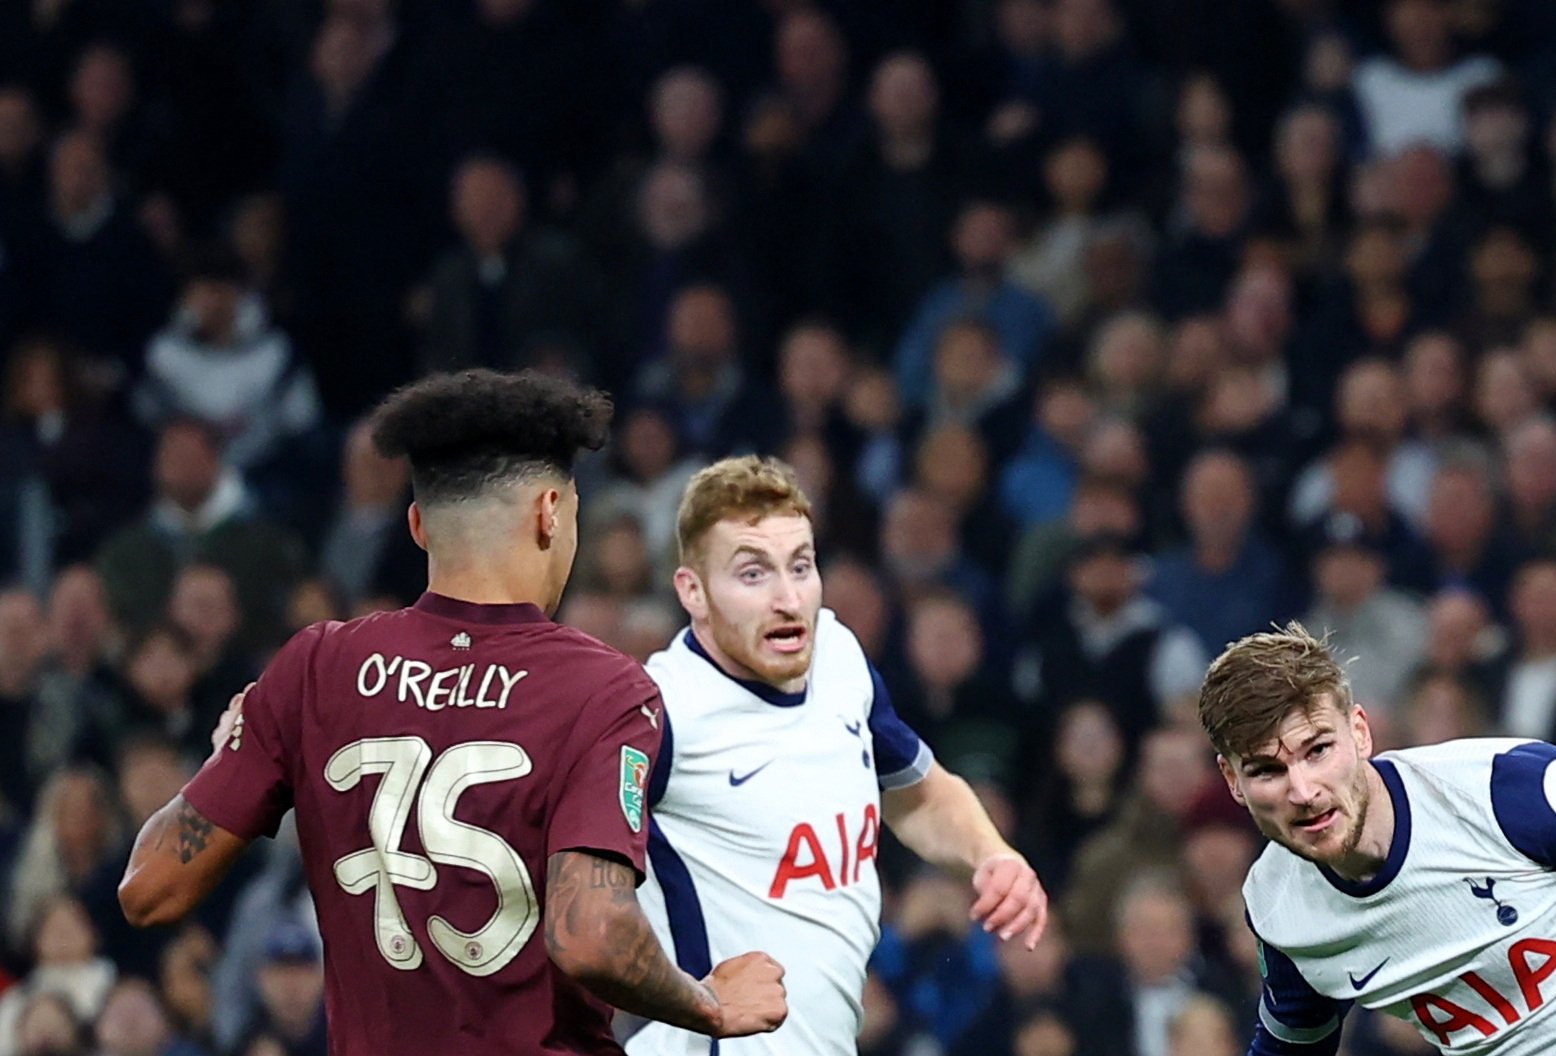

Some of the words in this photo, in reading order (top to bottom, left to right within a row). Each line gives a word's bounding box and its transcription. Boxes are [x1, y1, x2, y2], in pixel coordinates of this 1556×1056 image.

[357, 653, 528, 711] O'REILLY
[324, 736, 540, 977] 75
[768, 803, 880, 899] AIA
